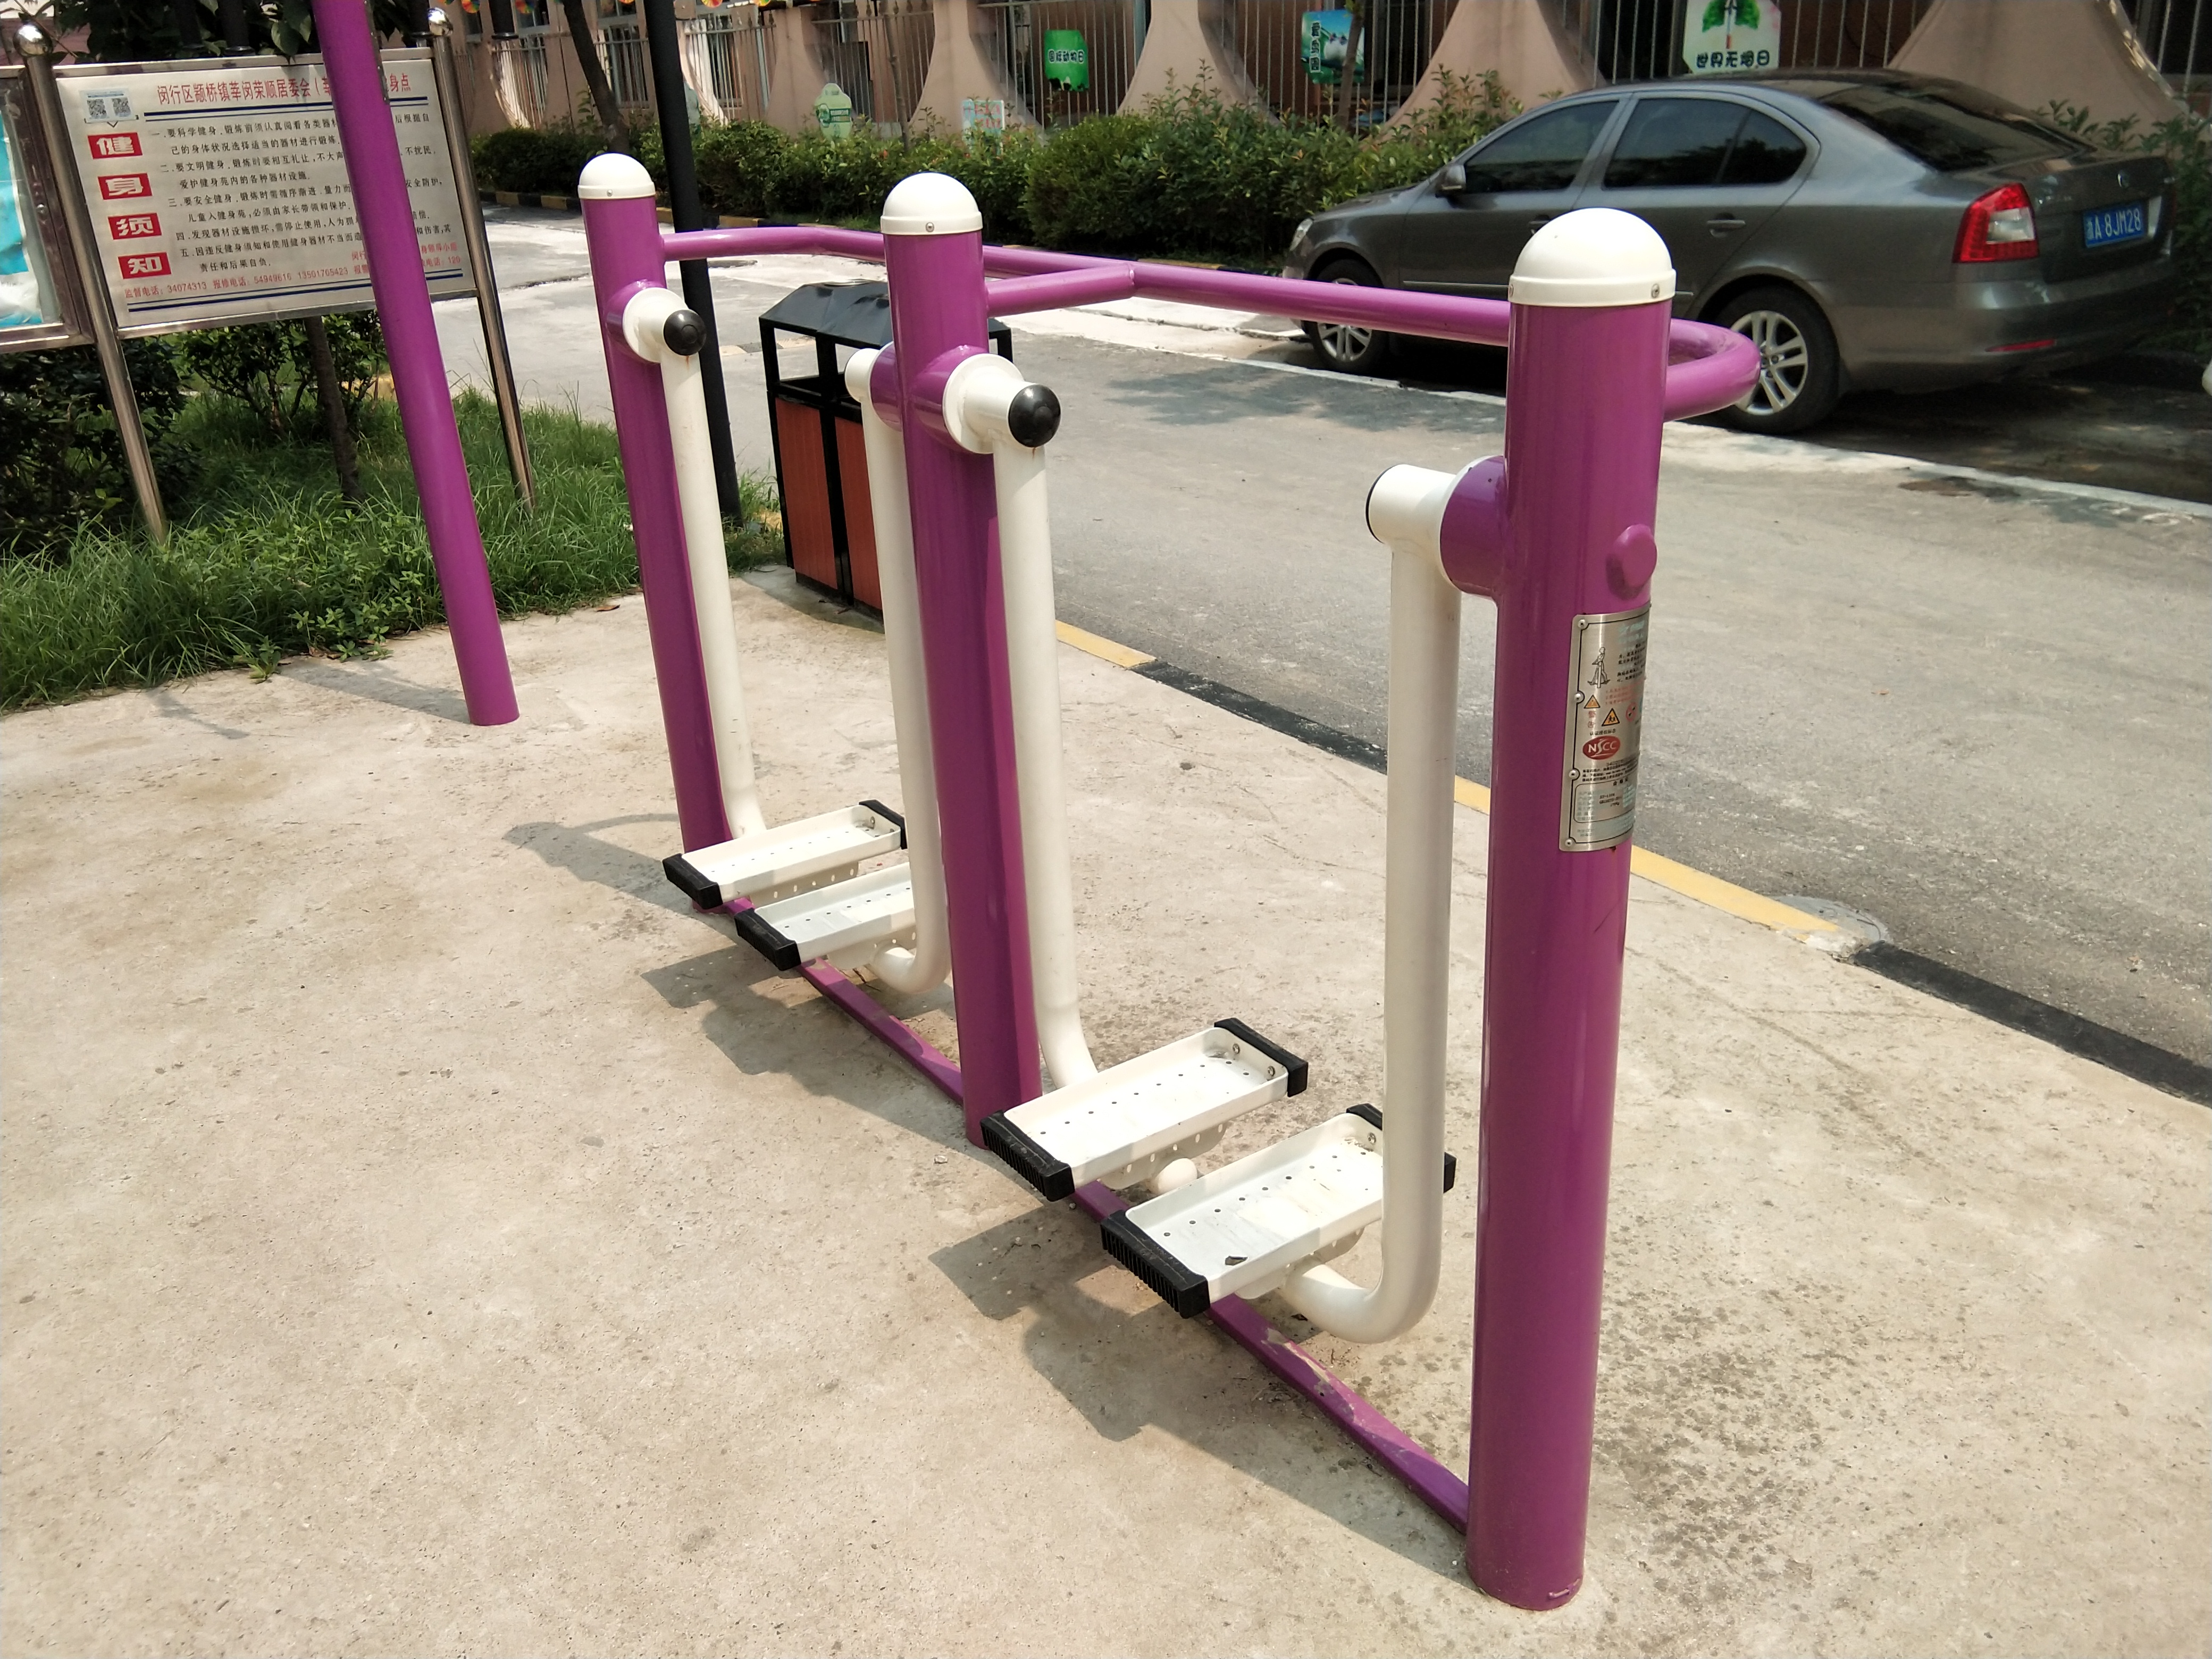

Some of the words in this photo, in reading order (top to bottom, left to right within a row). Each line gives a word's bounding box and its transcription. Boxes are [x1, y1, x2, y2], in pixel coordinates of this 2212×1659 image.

[1696, 49, 1770, 69] 世界无烟日
[1588, 739, 1616, 755] NSCC
